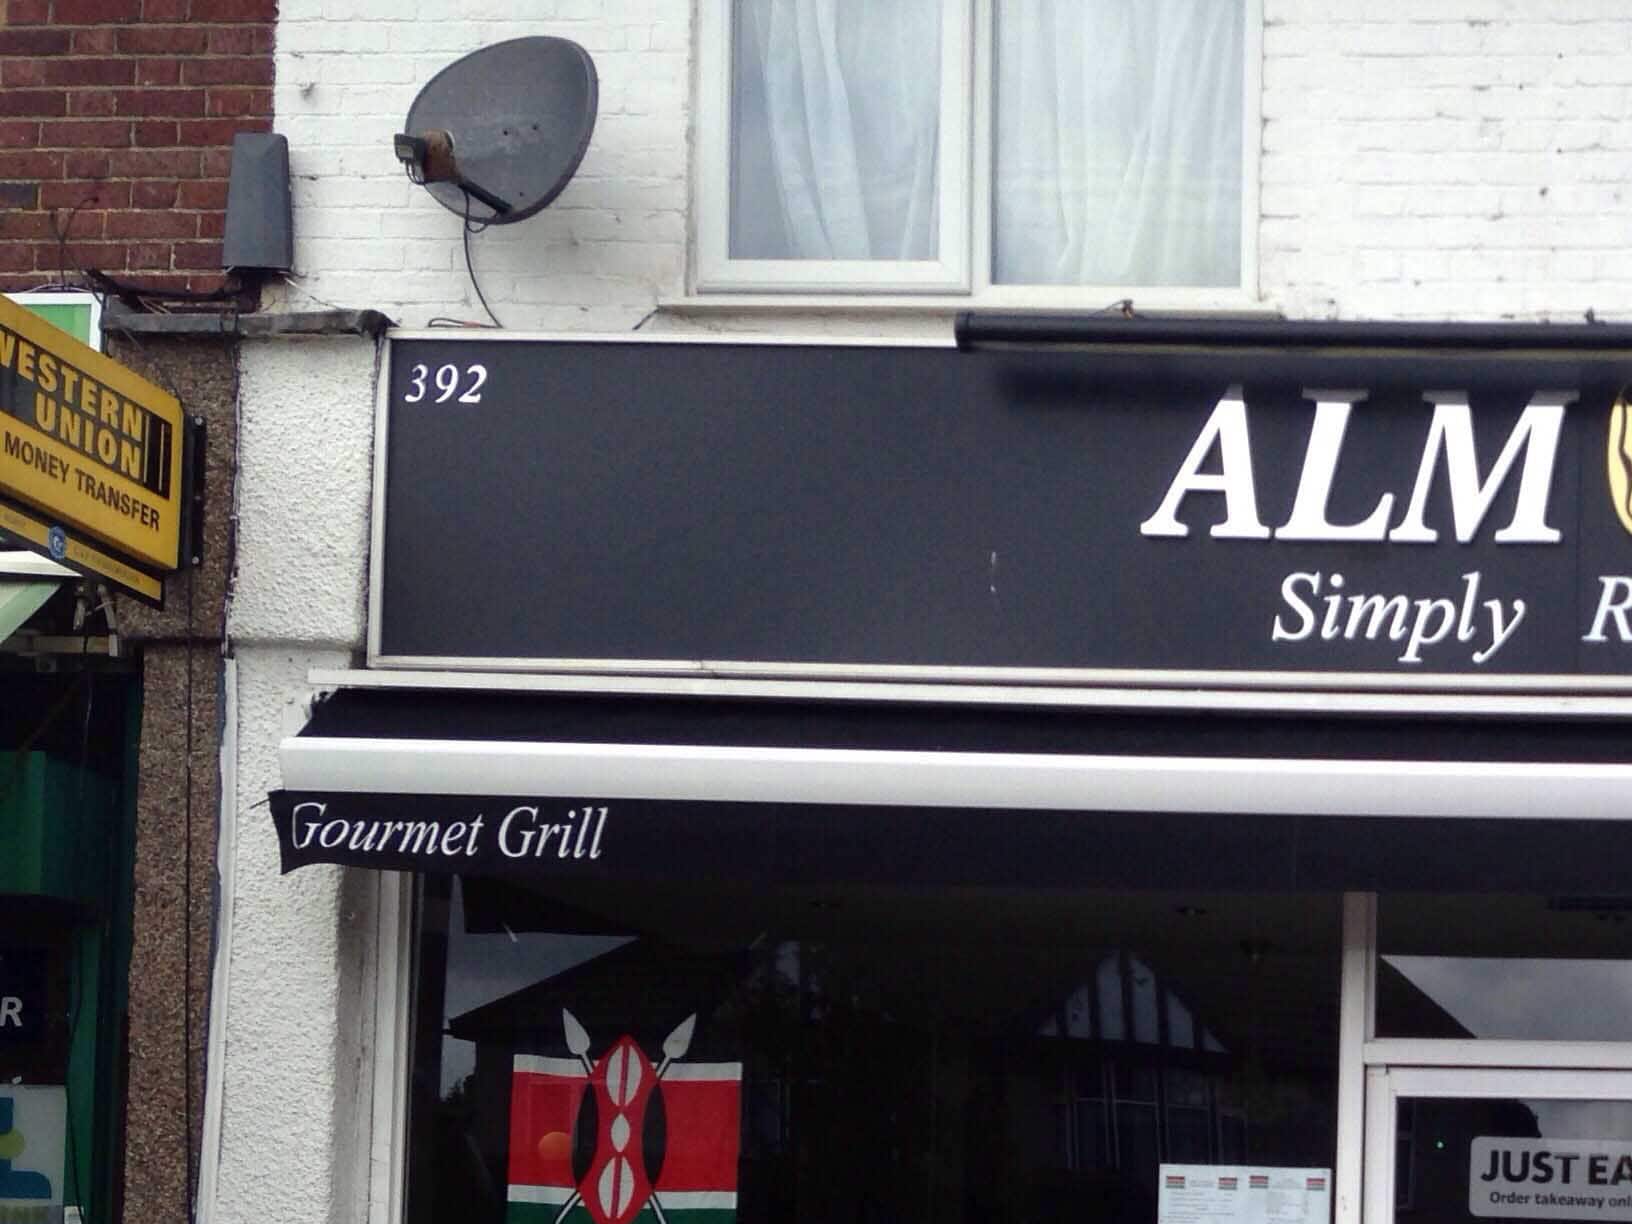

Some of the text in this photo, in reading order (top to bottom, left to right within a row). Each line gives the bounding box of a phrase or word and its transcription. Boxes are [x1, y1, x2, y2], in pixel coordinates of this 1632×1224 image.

[404, 364, 487, 403] 392
[36, 393, 140, 479] UNION
[5, 432, 160, 532] MONEY TRANSFER
[1272, 571, 1525, 662] Simply
[292, 802, 608, 860] Gourmet Grill
[1481, 1150, 1580, 1184] JUST
[1490, 1191, 1530, 1205] Order
[1535, 1193, 1605, 1209] takeaway
